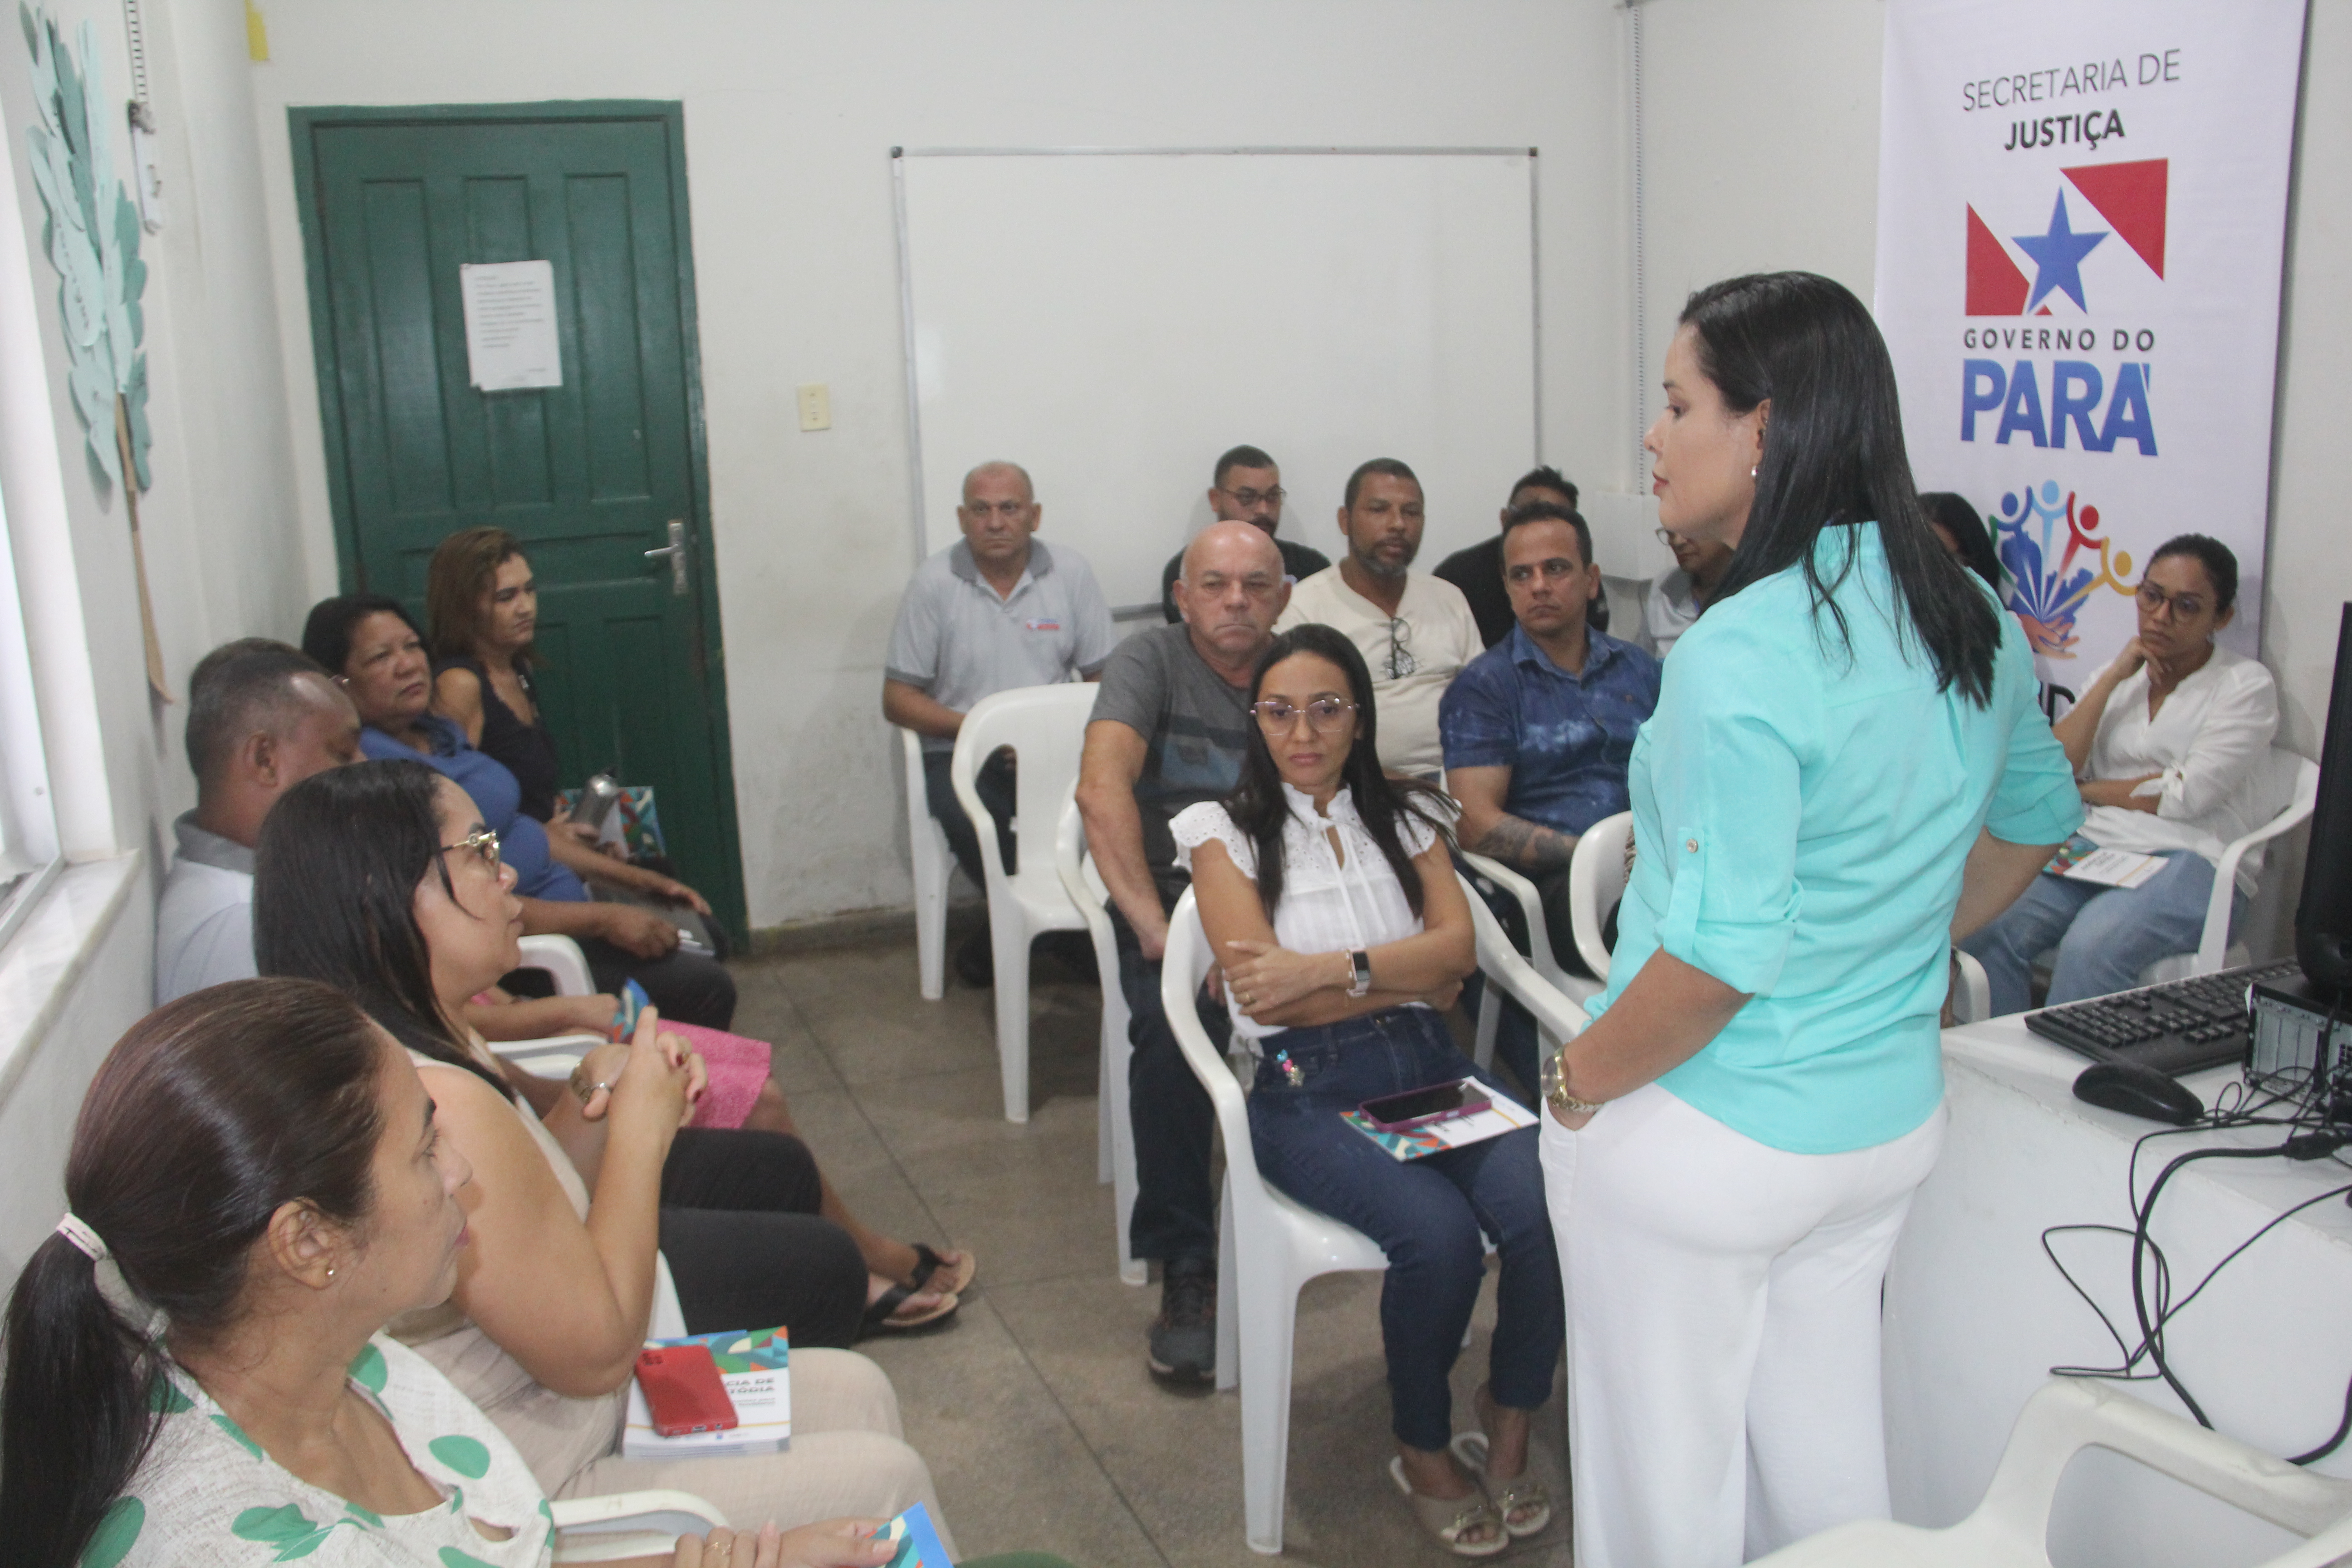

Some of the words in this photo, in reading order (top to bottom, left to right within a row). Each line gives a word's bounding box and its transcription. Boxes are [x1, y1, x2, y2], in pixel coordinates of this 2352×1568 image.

[1963, 59, 2128, 111] SECRETARIA
[2138, 49, 2180, 86] DE
[2004, 108, 2126, 151] JUSTIÇA
[1963, 328, 2096, 351] GOVERNO
[2112, 328, 2155, 352] DO
[1960, 358, 2159, 456] PARÁ
